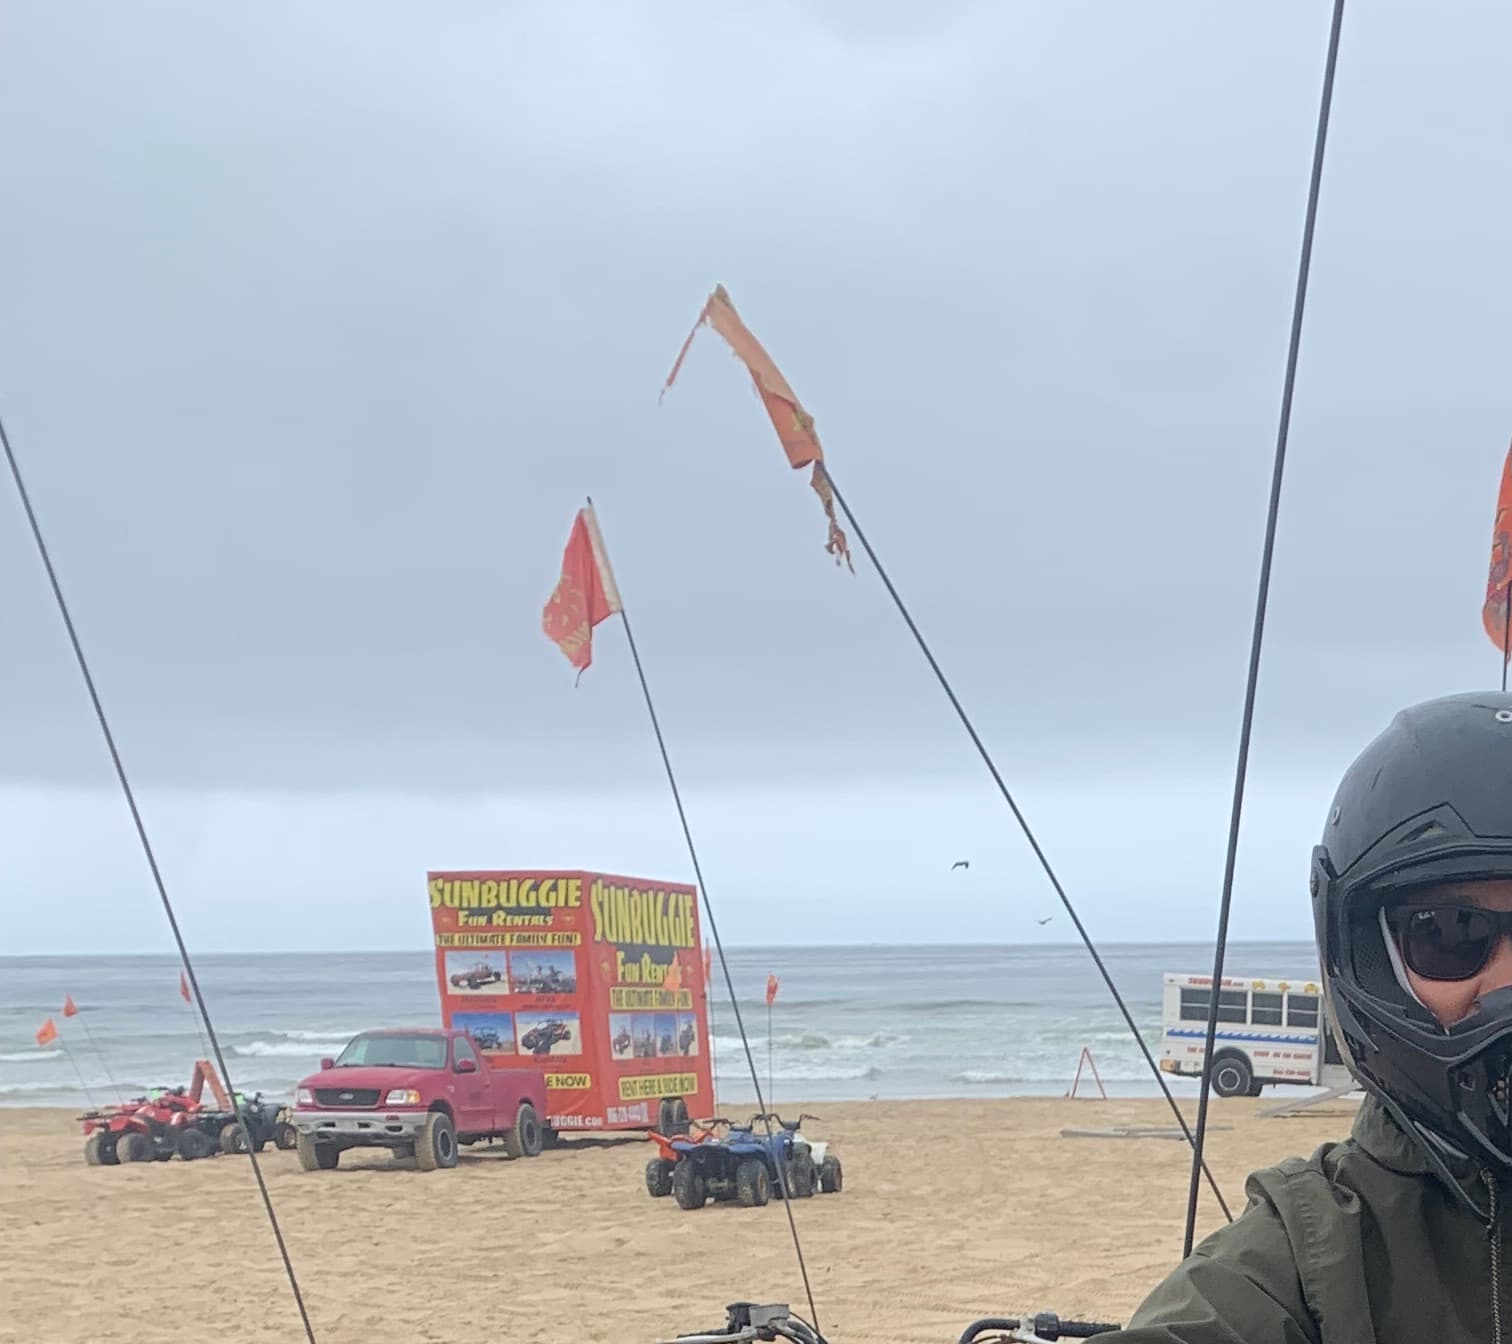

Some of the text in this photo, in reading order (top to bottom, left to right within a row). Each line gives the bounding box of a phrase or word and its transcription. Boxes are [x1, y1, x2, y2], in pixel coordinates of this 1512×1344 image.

[428, 878, 583, 908] SUNBUGGIE
[590, 878, 695, 949] SUNBUGGIE
[555, 1075, 588, 1087] NOW
